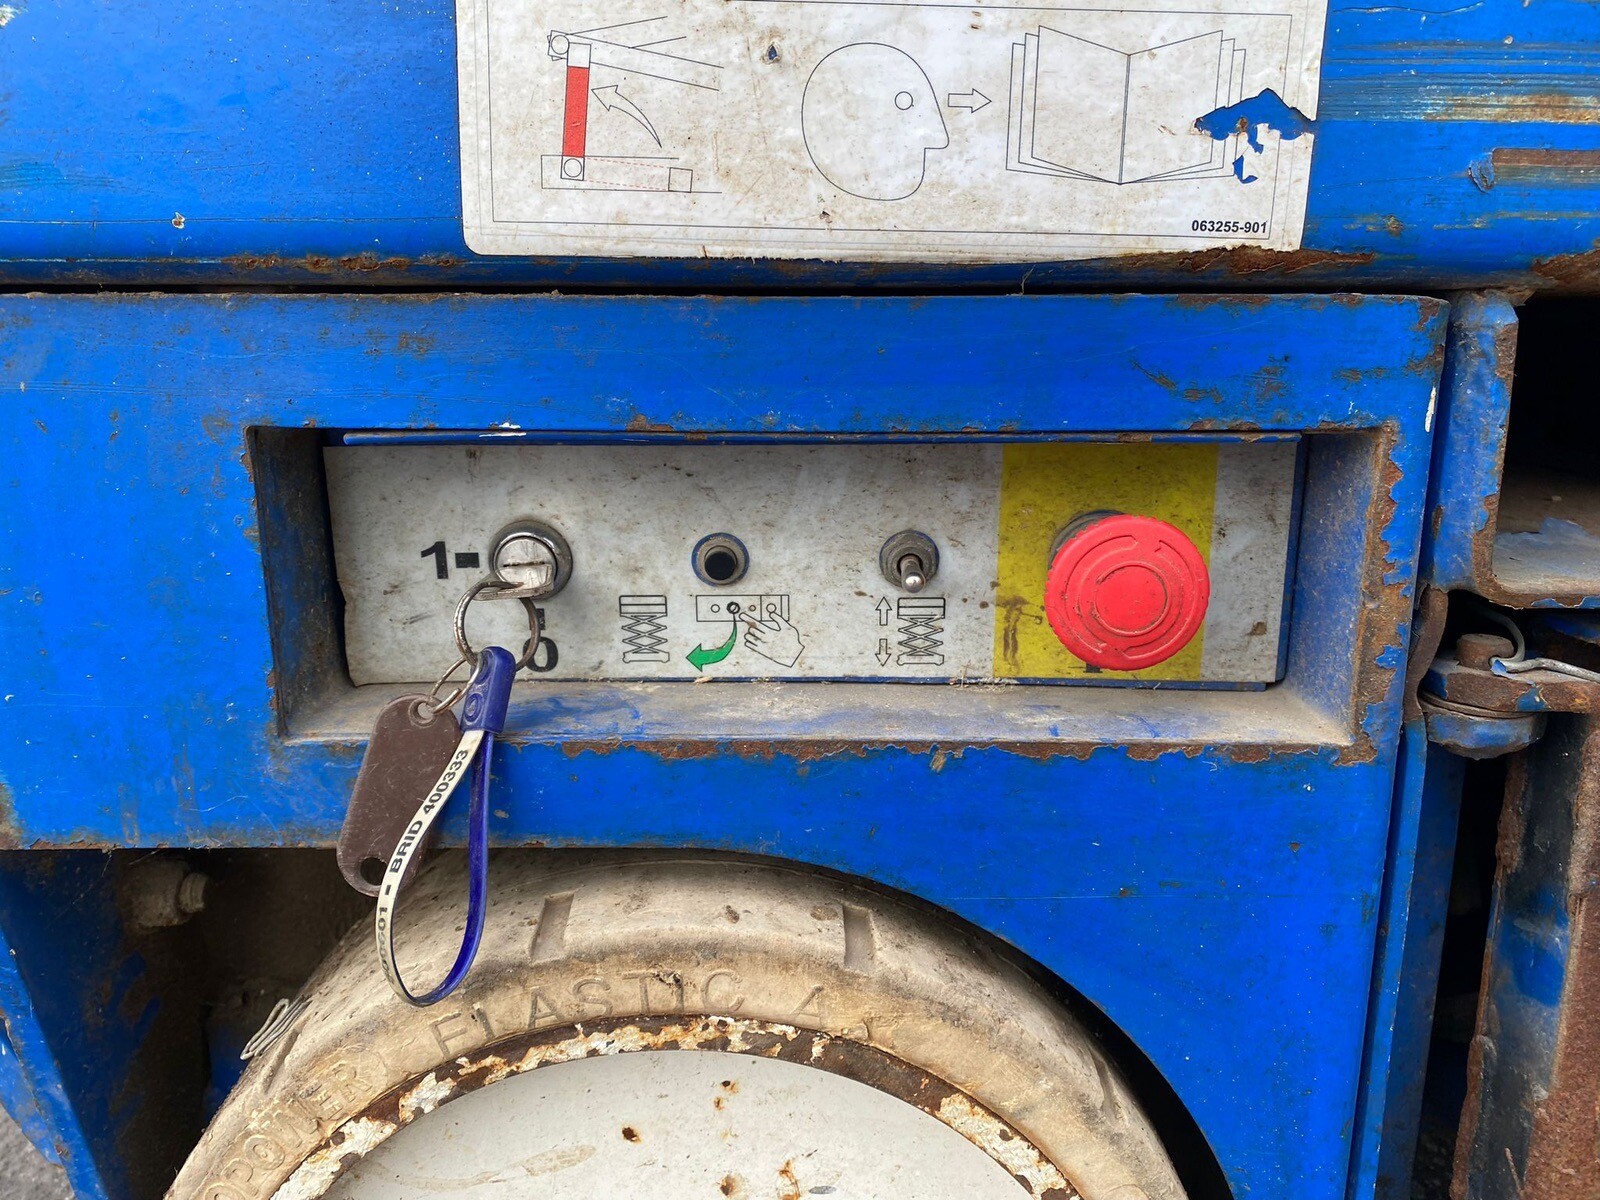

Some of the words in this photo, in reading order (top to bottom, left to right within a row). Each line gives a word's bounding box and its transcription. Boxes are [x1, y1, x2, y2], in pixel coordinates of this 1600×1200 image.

[1191, 220, 1267, 233] 063255-901
[388, 820, 423, 873] BRID
[422, 749, 469, 815] 400333
